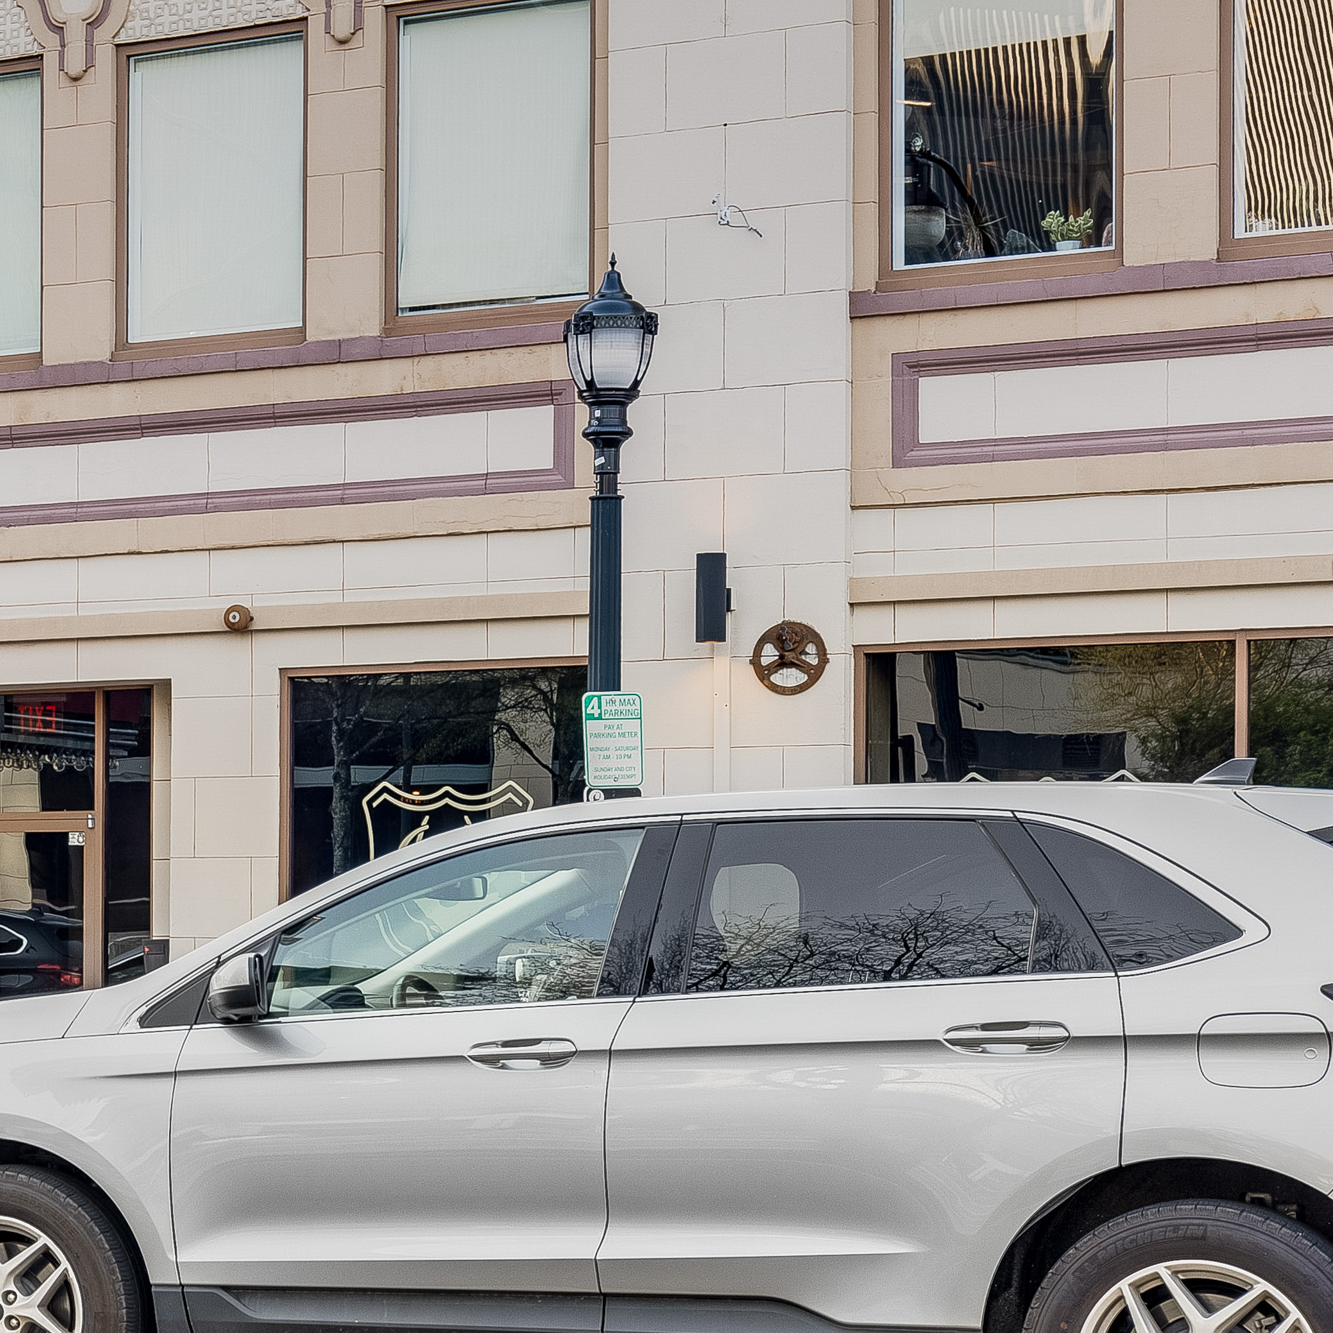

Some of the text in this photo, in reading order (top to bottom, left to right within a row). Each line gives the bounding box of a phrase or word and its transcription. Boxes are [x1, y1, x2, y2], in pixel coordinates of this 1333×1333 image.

[586, 696, 601, 718] 4
[605, 698, 637, 707] HR MAX
[603, 709, 639, 717] PARKING
[1098, 1225, 1206, 1260] MICHELIN
